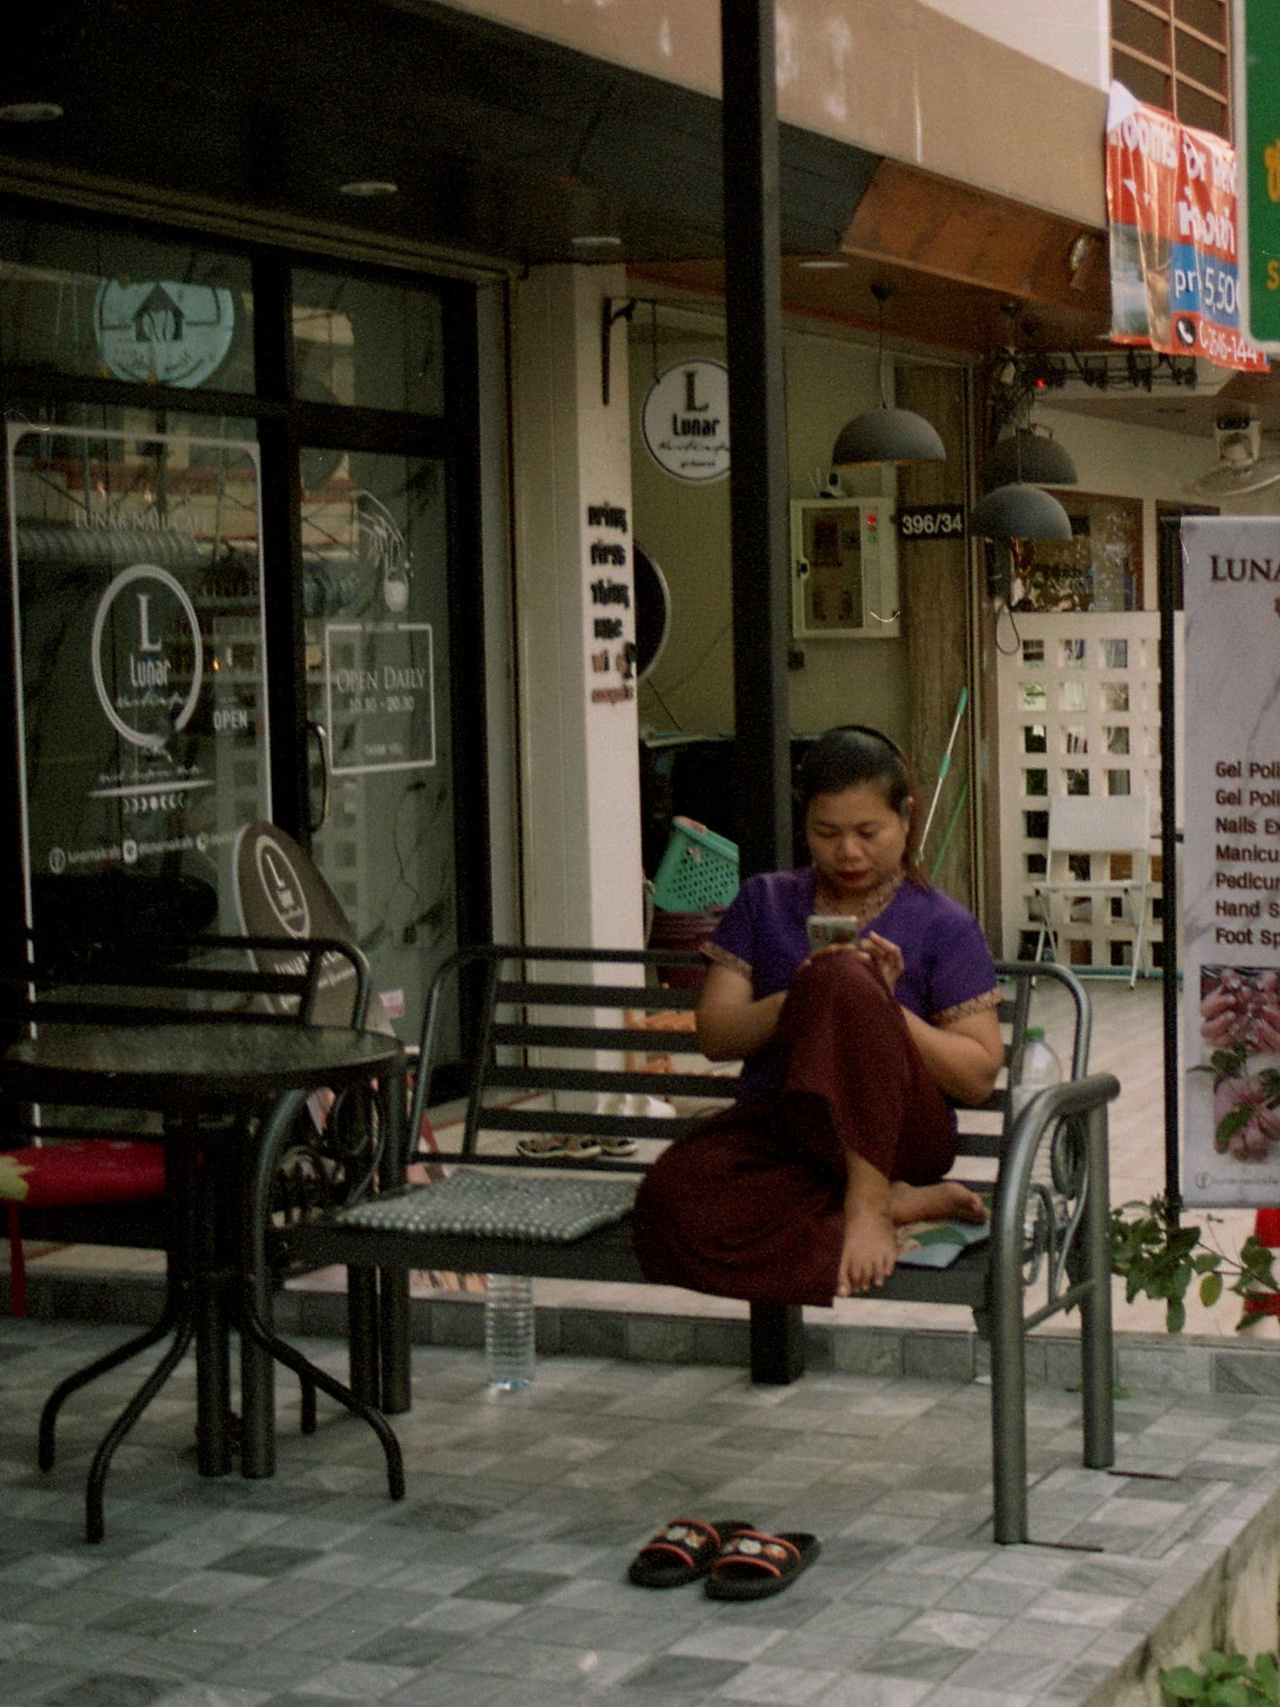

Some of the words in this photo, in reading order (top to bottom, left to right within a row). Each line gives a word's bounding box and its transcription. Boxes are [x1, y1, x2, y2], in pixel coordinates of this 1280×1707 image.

[1205, 268, 1240, 313] 5,50
[684, 370, 709, 412] L
[672, 414, 721, 437] Lunar
[902, 513, 963, 535] 396/34
[137, 594, 162, 651] L
[129, 653, 172, 687] Lunar
[213, 708, 249, 731] OPEN
[1216, 761, 1241, 778] Gel
[1216, 790, 1241, 806] Gel
[1216, 817, 1256, 835] Nails
[1216, 901, 1260, 918] Hand
[1216, 928, 1253, 945] Foot
